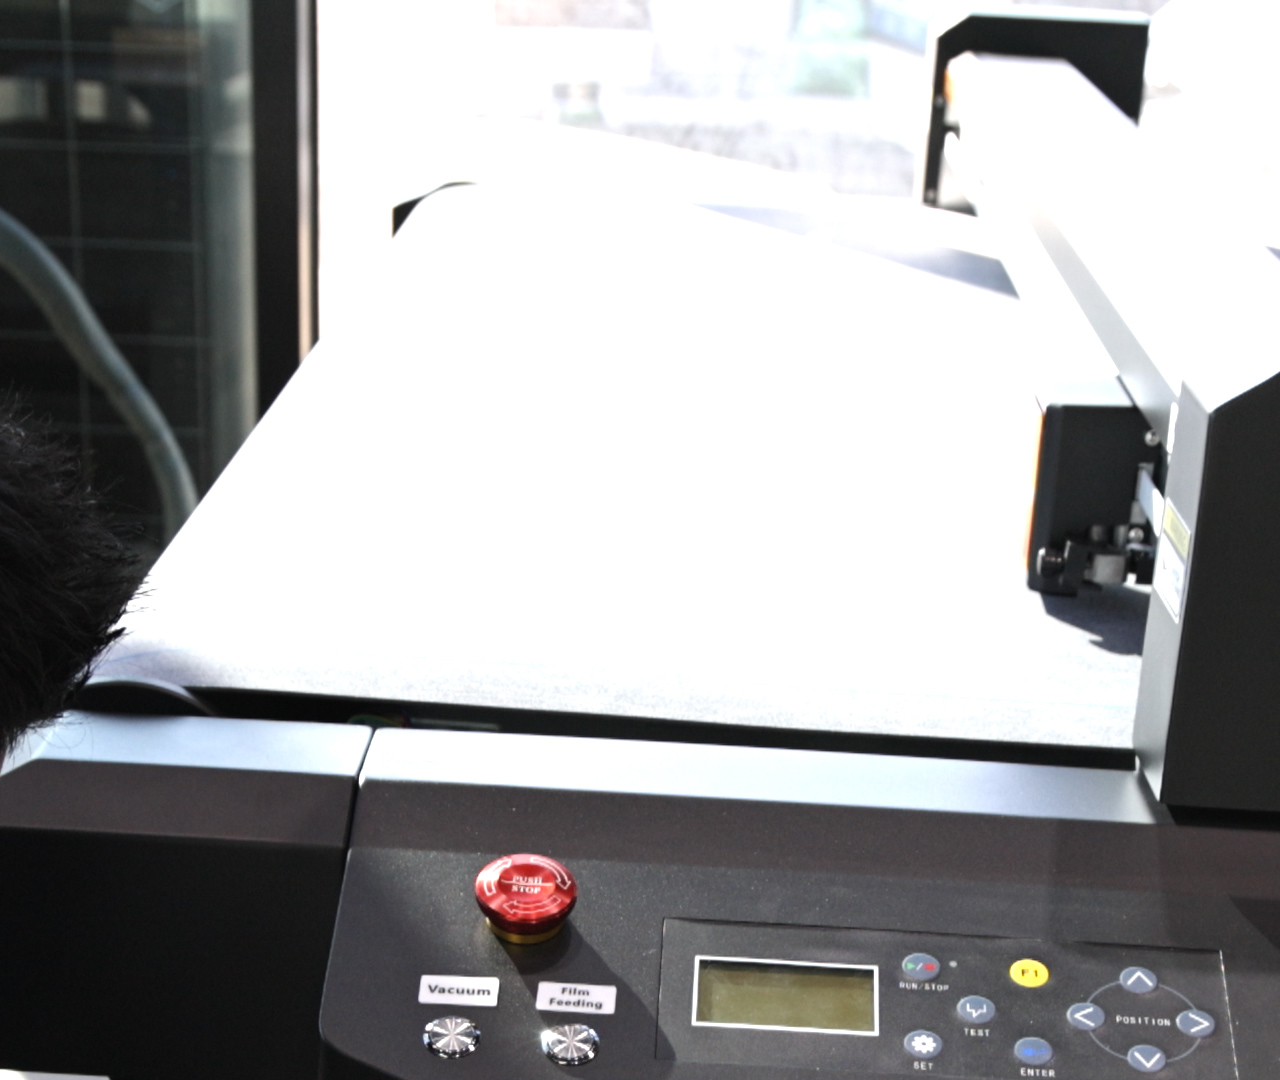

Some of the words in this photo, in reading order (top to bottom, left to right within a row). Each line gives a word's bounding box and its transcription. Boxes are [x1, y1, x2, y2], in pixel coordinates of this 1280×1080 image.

[511, 884, 542, 894] STOP
[1021, 968, 1039, 978] F1
[427, 984, 491, 996] Vacuum
[561, 986, 590, 996] Film
[899, 981, 950, 992] RUN/STOP
[548, 997, 603, 1010] Feeding
[1115, 1014, 1171, 1026] POSITION
[963, 1027, 991, 1037] TEST
[913, 1061, 933, 1071] SET
[1020, 1067, 1056, 1078] ENTER
